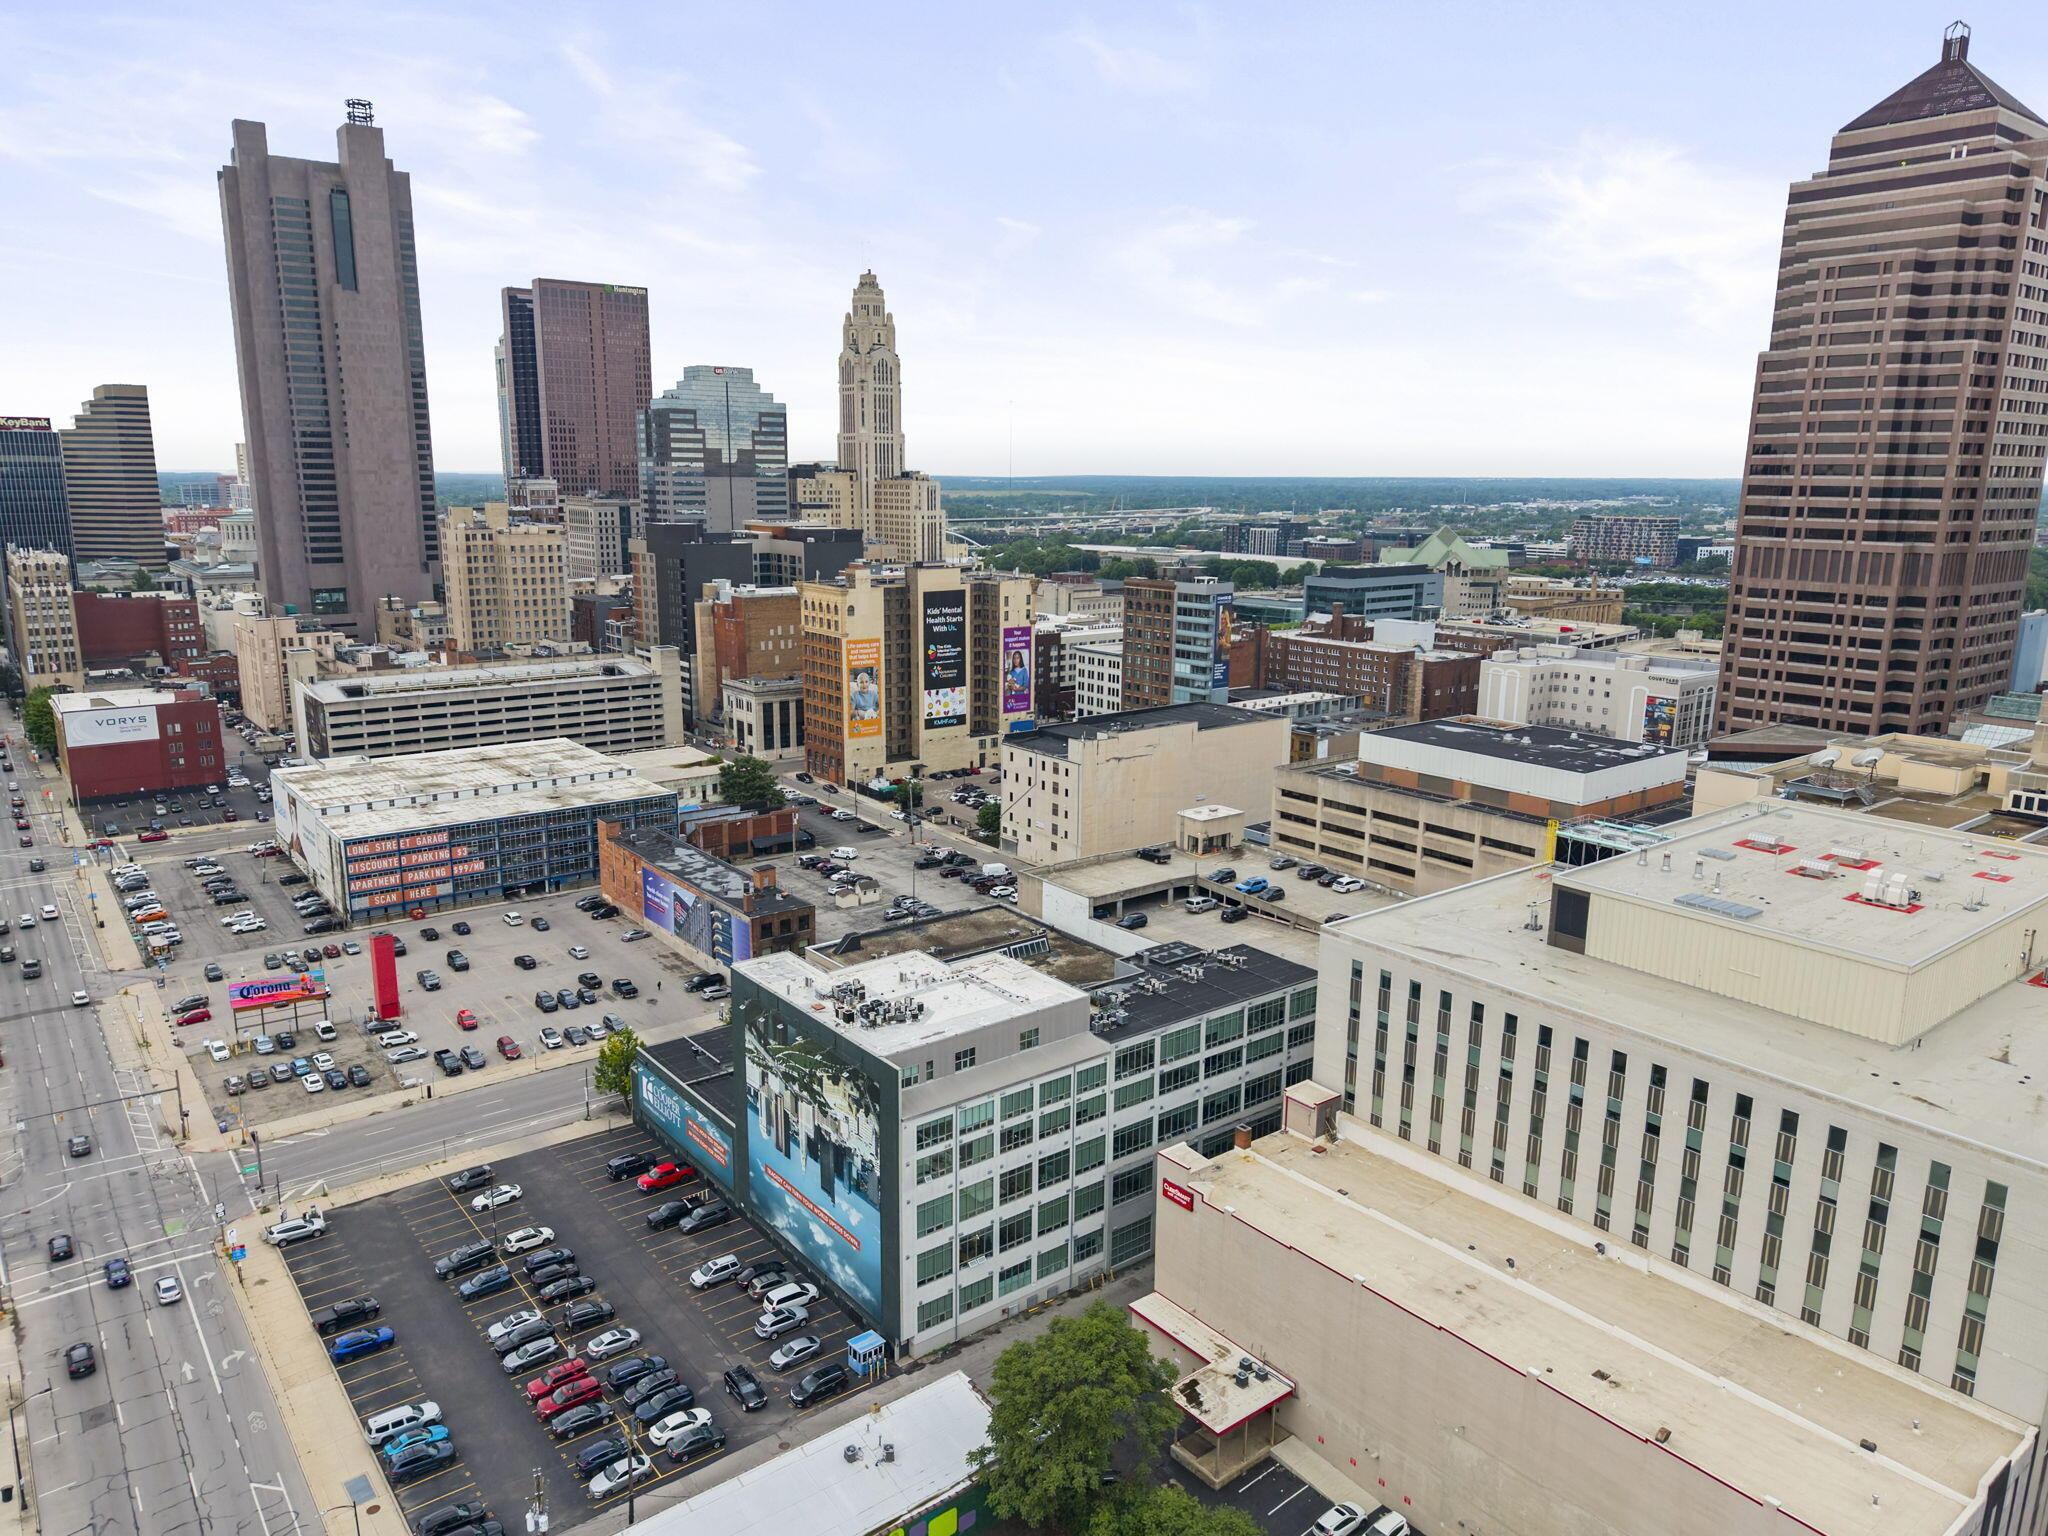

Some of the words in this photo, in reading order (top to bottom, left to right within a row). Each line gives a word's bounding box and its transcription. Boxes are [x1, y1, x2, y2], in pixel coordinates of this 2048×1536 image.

[0, 418, 49, 428] KeyBank
[926, 616, 945, 624] Health
[946, 615, 963, 623] Starts
[927, 607, 941, 615] Kids'
[942, 606, 962, 614] Mental
[933, 624, 947, 632] With
[1648, 675, 1679, 683] COURTYARD
[95, 715, 147, 727] VORYS
[347, 845, 370, 856] LONG
[375, 838, 411, 852] STREET
[416, 833, 449, 846] GARAGE
[348, 856, 407, 873] DISCOUNTED
[412, 849, 450, 863] PARKING
[456, 847, 467, 856] $3
[350, 874, 401, 891] APARTMENT
[408, 868, 446, 881] PARKING
[453, 861, 484, 874] $99/MO
[374, 893, 397, 905] SCAN
[410, 887, 431, 899] HERE
[240, 982, 291, 1000] Corona
[653, 1085, 680, 1116] COOPER
[653, 1096, 681, 1128] ELLIOTT
[783, 1181, 792, 1192] CAN
[791, 1187, 803, 1201] TURN
[802, 1197, 814, 1211] YOUR
[813, 1207, 829, 1223] WORLD
[828, 1218, 843, 1234] UPSIDE
